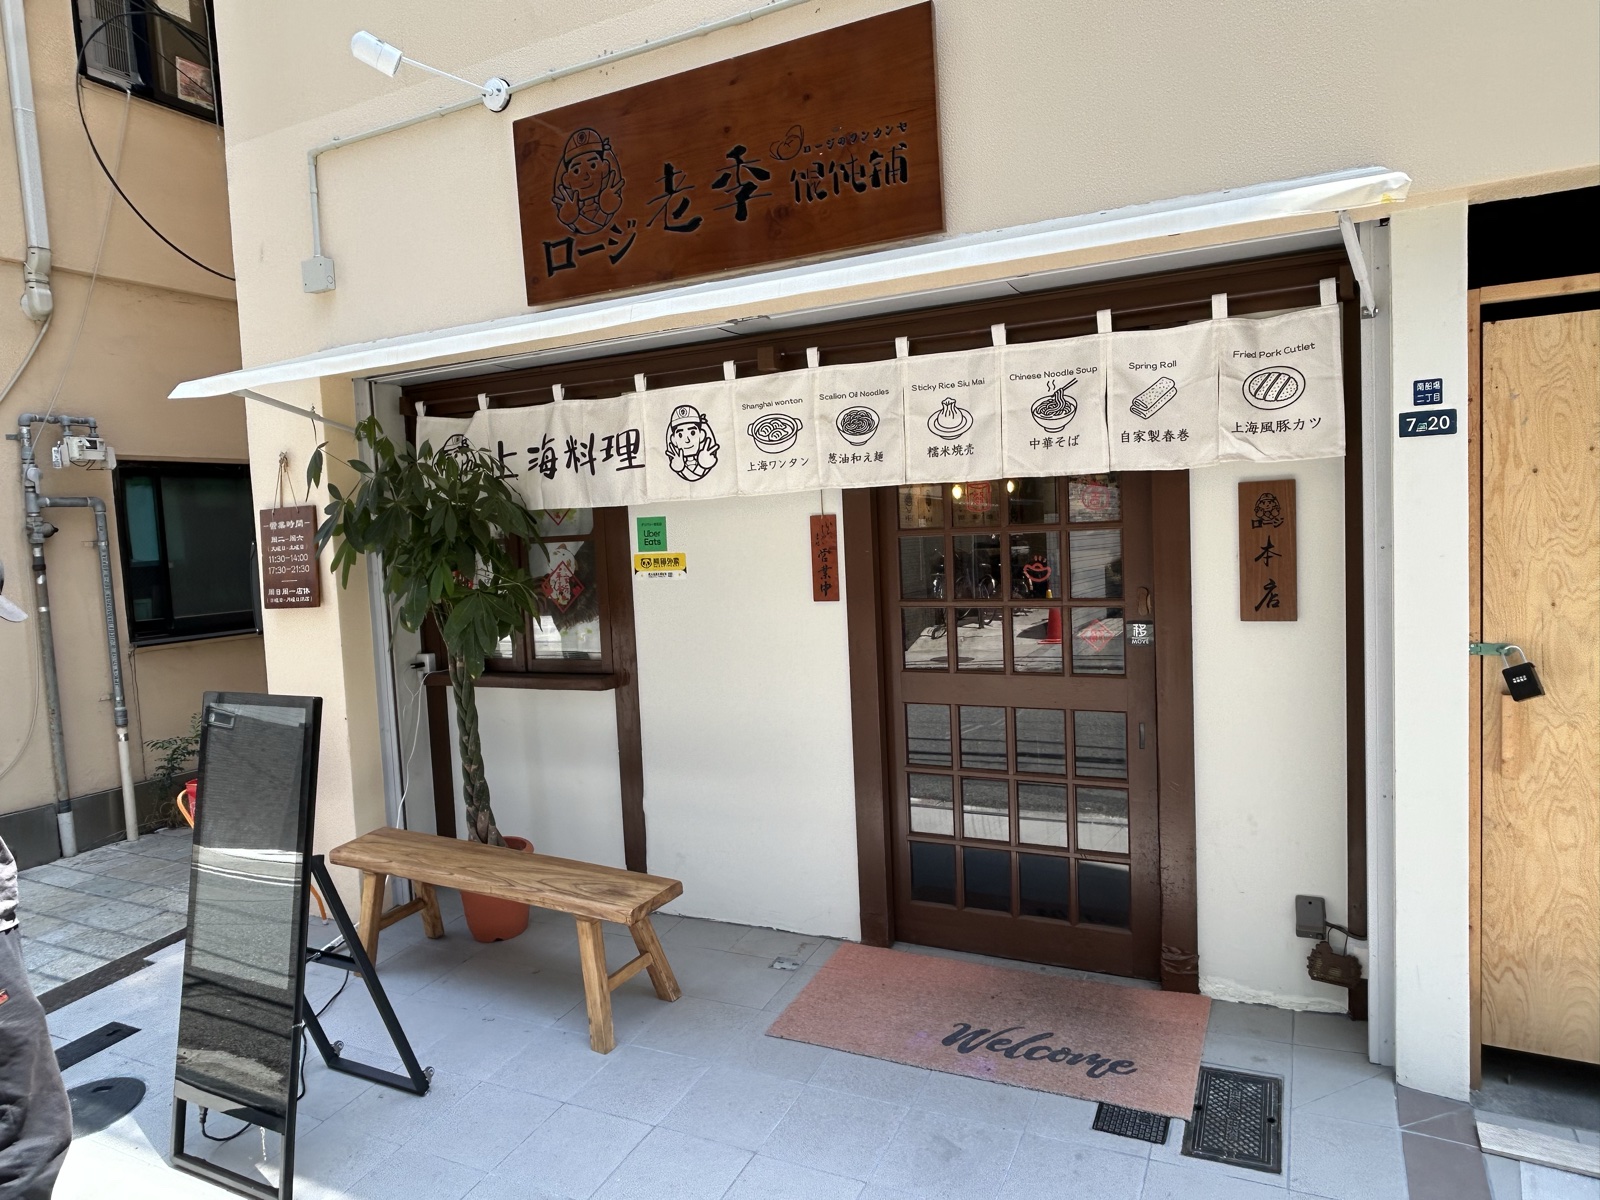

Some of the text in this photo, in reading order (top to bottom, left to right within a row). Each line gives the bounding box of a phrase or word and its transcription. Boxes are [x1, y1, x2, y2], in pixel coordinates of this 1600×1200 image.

[646, 144, 773, 234] 老季
[542, 219, 637, 278] ロージ
[1232, 342, 1316, 359] Fried Pork Cutlet
[1128, 360, 1177, 371] Spring Roll
[1009, 366, 1098, 381] Chinese Noodle Soup
[911, 377, 985, 392] Sticky Rice Siu Mai
[1416, 381, 1441, 391] 南船場
[819, 392, 847, 401] Scallion
[859, 388, 890, 397] Noodles
[1416, 392, 1440, 403] 二丁目
[741, 397, 803, 410] Shanghai wonton
[1231, 417, 1322, 435] 上海風豚カツ
[1406, 415, 1451, 432] 720
[1029, 434, 1080, 450] 中華そば
[1120, 428, 1190, 443] 自家製春巻
[494, 428, 646, 480] 上海料理
[747, 457, 810, 472] 上海ワンタン
[1251, 518, 1285, 529] ロージ
[643, 530, 661, 538] Uber
[644, 538, 662, 546] Eats
[817, 548, 833, 597] 営業中
[1254, 535, 1283, 612] 本店
[941, 1022, 1138, 1079] Welcome
